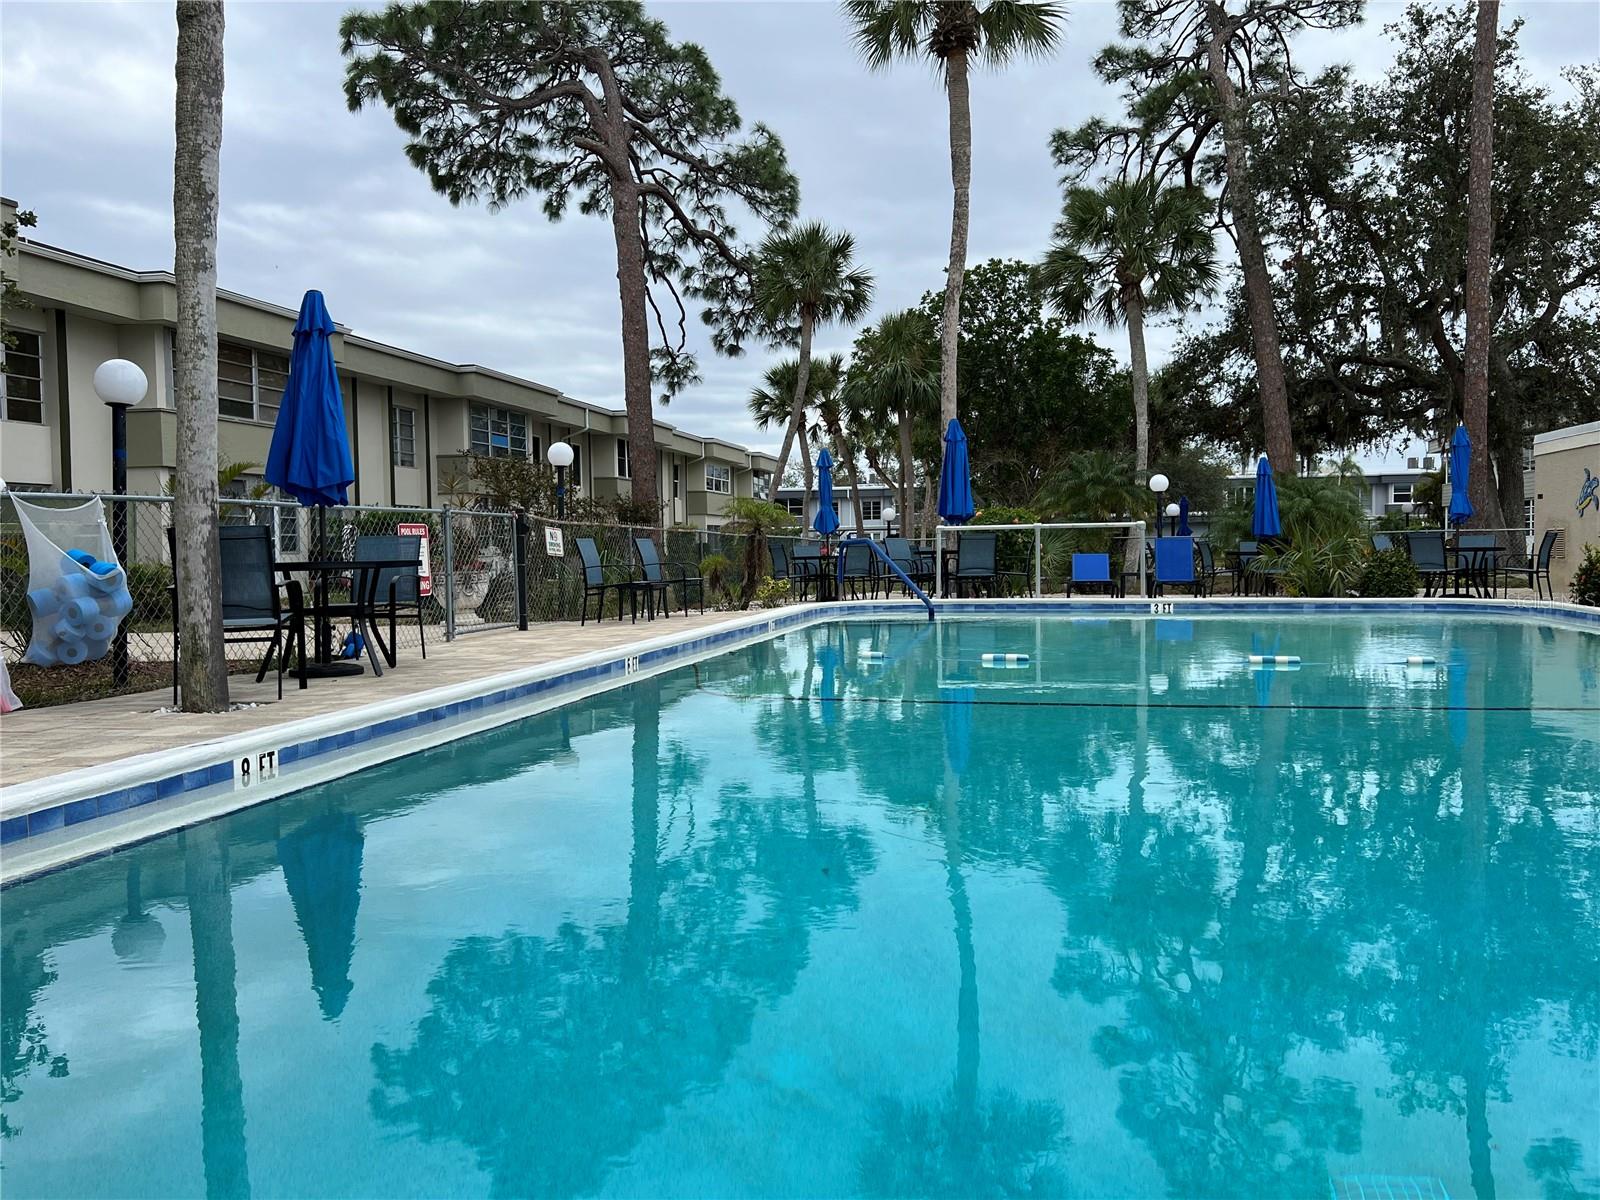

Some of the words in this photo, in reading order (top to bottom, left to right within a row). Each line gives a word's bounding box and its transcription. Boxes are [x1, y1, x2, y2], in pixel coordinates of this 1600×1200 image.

[400, 527, 412, 536] POOL
[412, 527, 426, 536] RULES
[1154, 603, 1159, 614] 3
[1163, 603, 1172, 614] FT
[259, 751, 275, 775] FT
